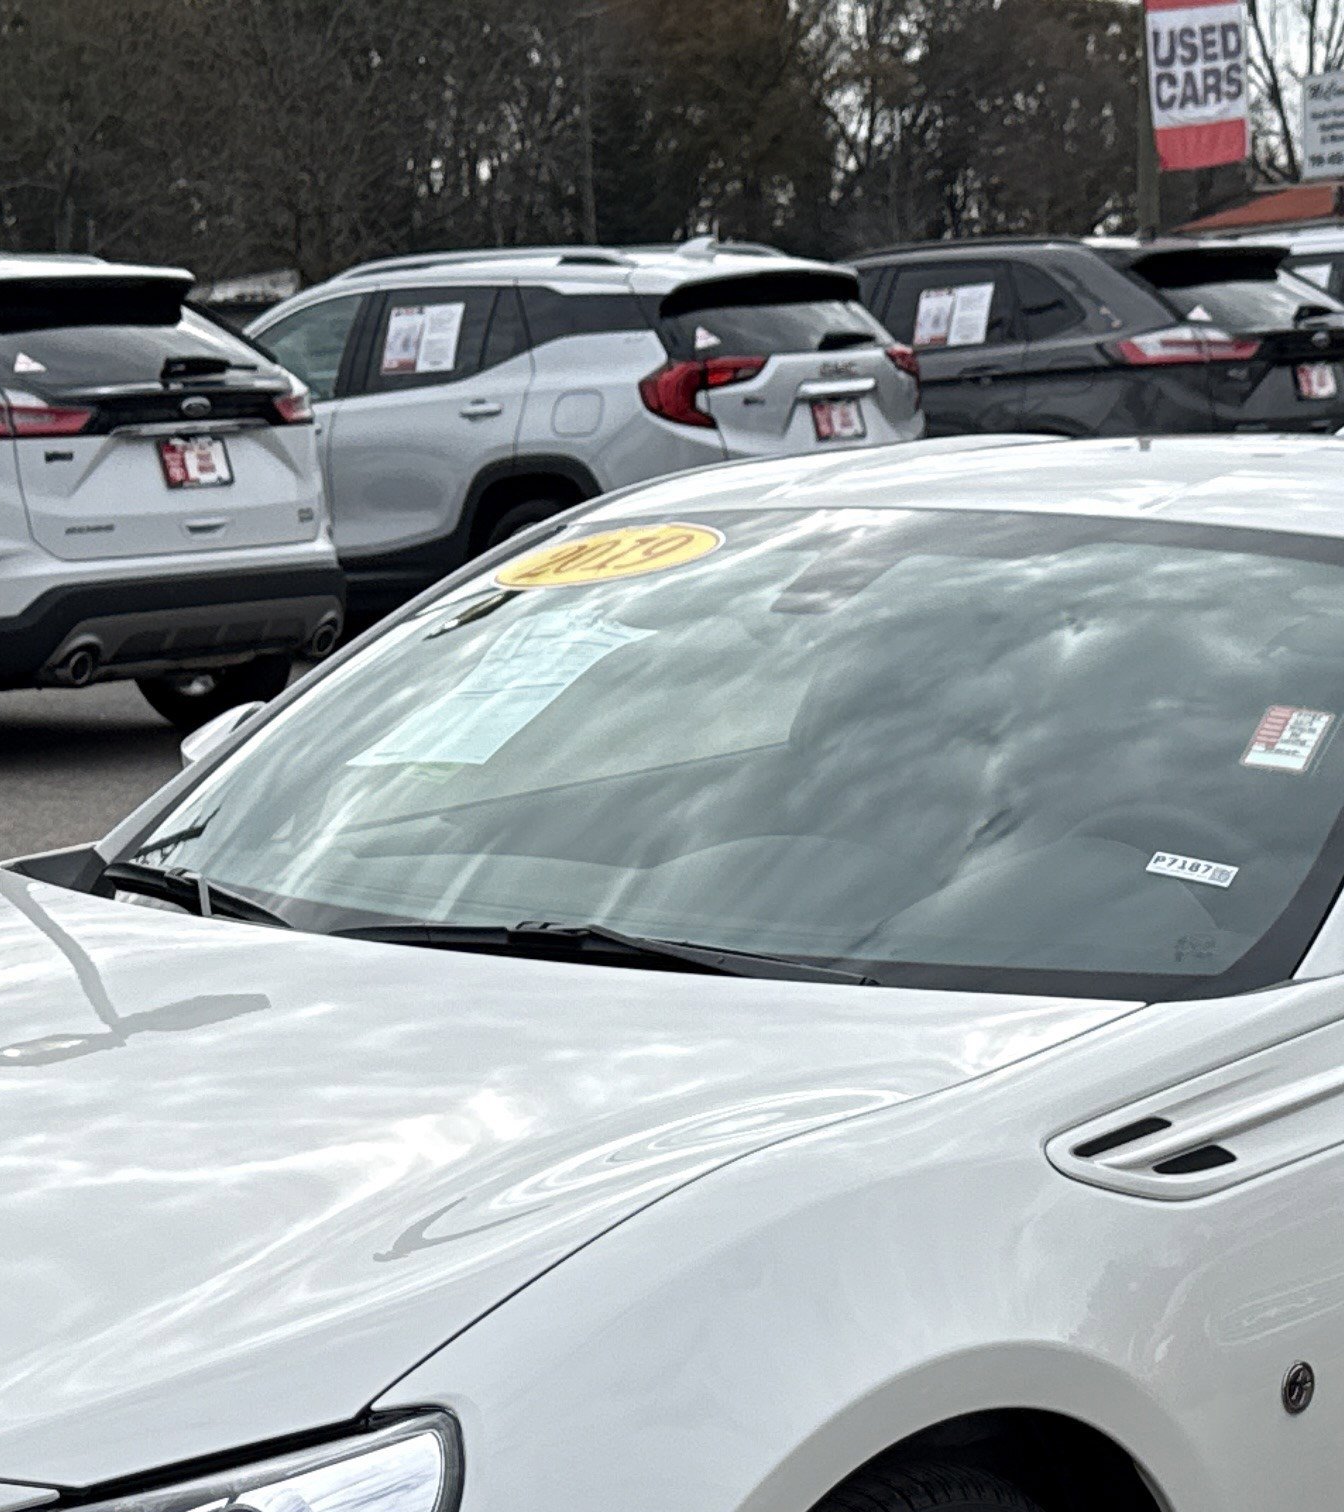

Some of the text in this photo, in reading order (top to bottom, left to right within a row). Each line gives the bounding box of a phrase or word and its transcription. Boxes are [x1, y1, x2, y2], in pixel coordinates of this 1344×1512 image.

[1152, 22, 1242, 67] USED
[1156, 62, 1243, 110] CARS
[514, 534, 695, 581] 2019
